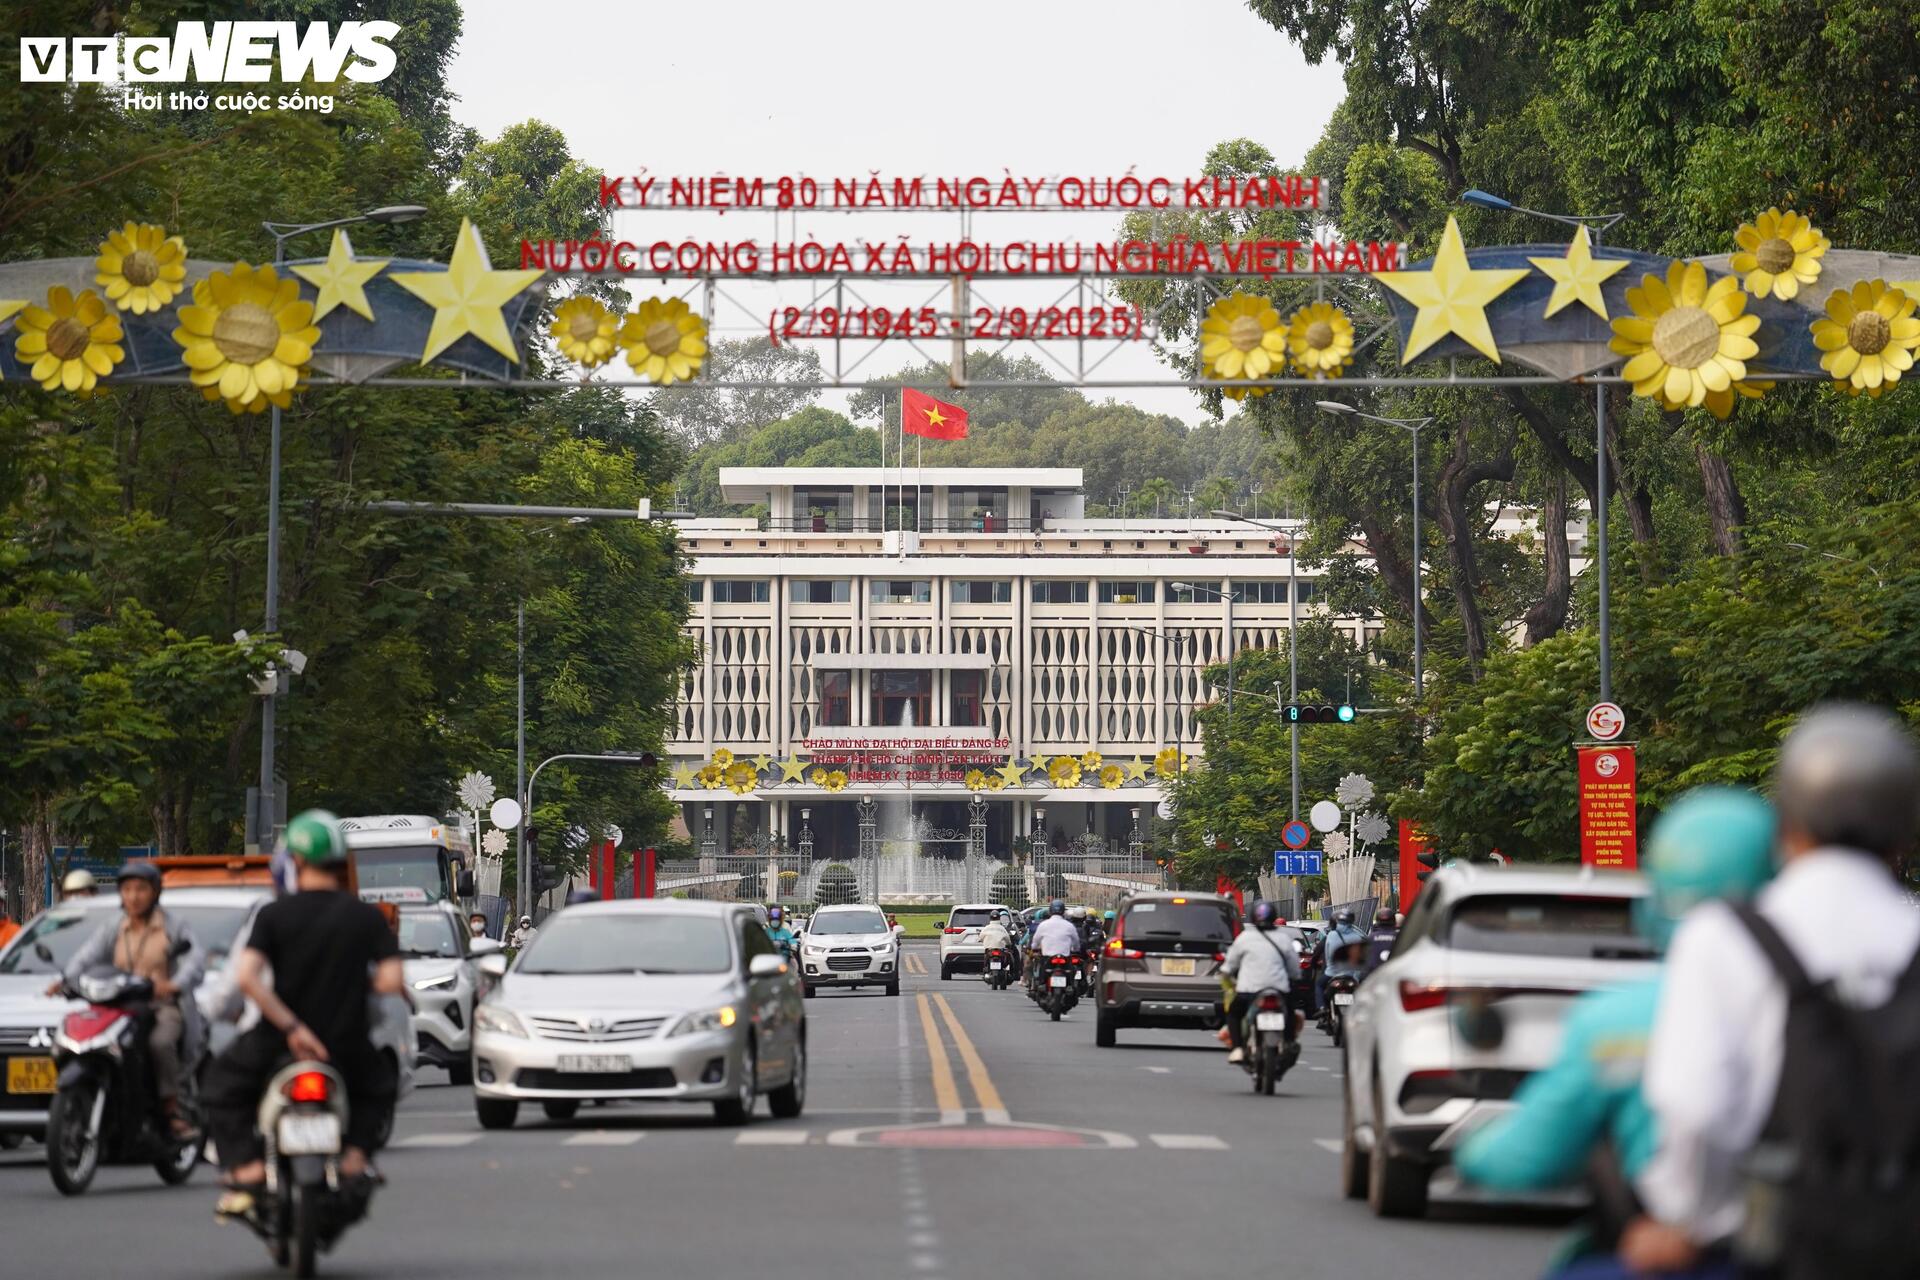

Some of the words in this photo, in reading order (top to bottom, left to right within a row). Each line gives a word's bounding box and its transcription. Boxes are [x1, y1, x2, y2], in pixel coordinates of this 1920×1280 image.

[671, 172, 763, 215] NIỆM
[777, 176, 817, 209] 80
[834, 169, 922, 208] NĂM
[937, 167, 1045, 208] NGÀY
[1057, 165, 1171, 210] QUỐC
[520, 230, 636, 272] NƯỚC
[650, 236, 759, 278] CỘNG
[772, 232, 852, 273] HÒA
[865, 235, 917, 273] XÃ
[1096, 234, 1212, 273] NGHĨA
[1221, 239, 1299, 281] VIỆT
[1312, 242, 1399, 273] NAM
[770, 305, 938, 347] (2/9/1945
[974, 303, 1143, 342] 2/9/2025)
